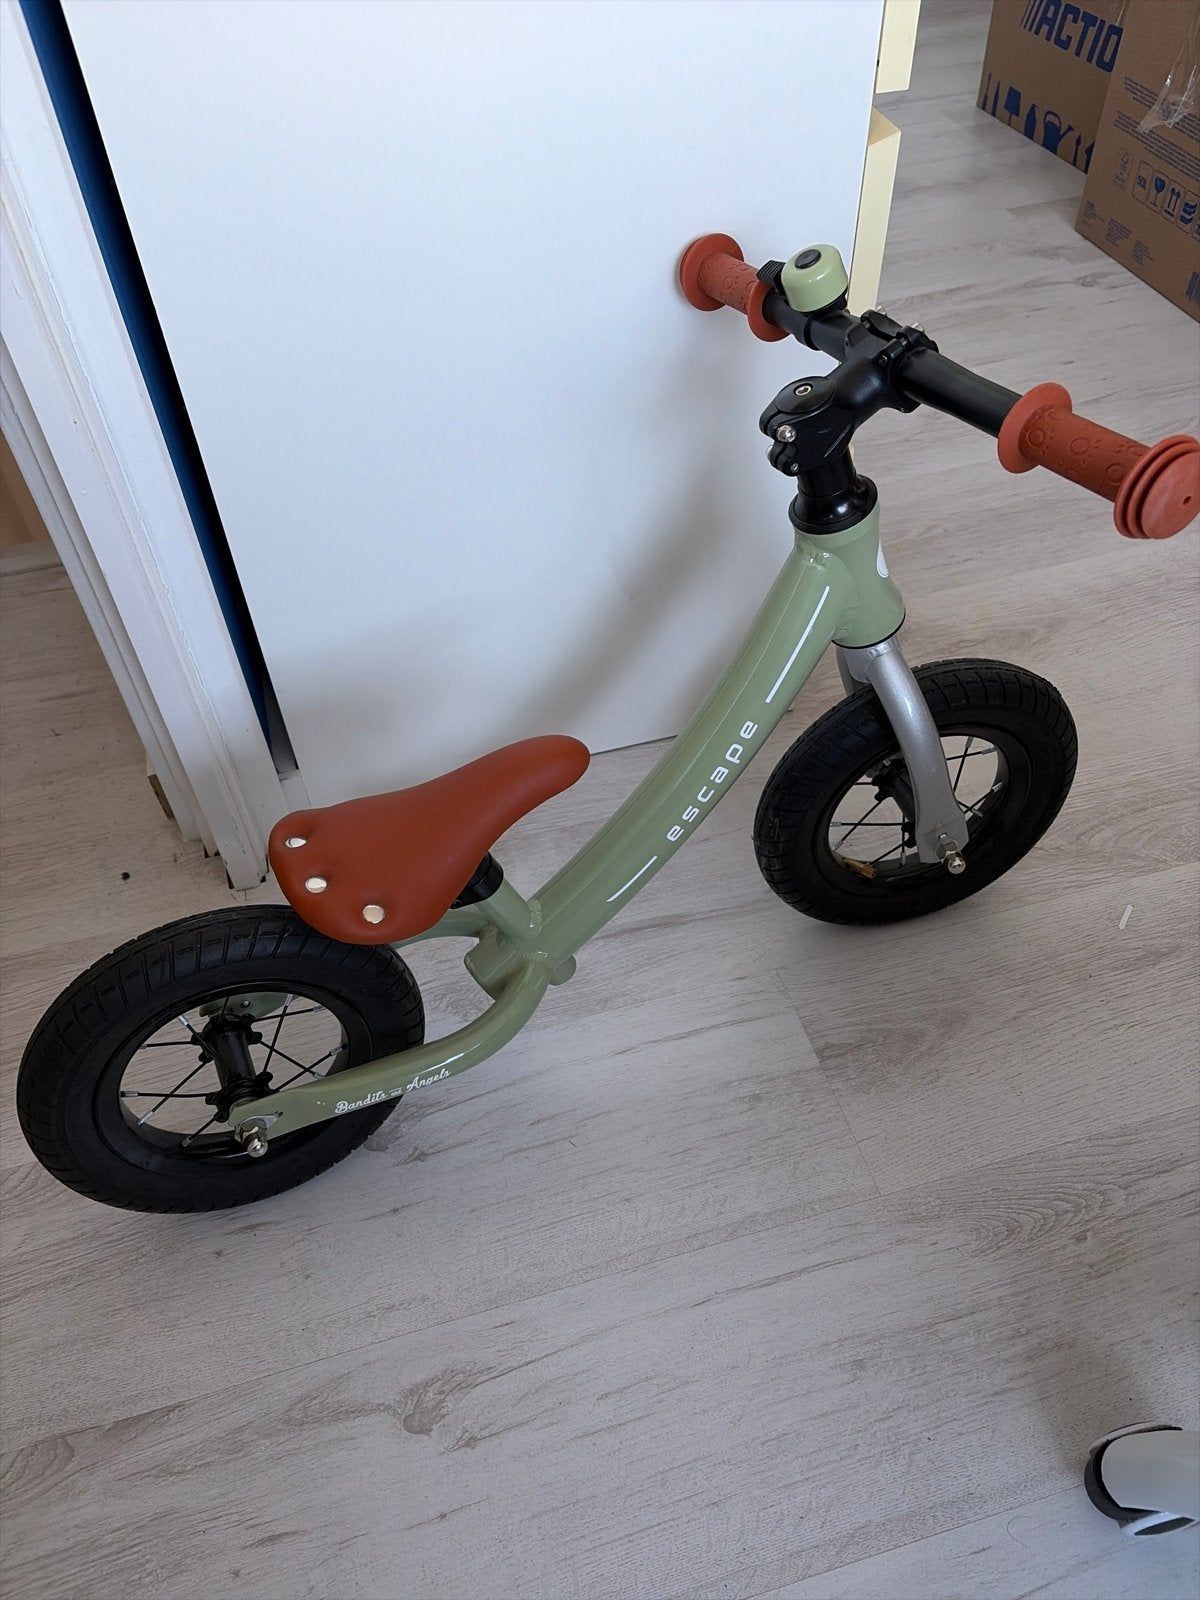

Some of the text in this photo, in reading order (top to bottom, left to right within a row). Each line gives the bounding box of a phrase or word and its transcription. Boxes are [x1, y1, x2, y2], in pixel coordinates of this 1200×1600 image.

[1034, 0, 1124, 73] ACTIO
[666, 720, 759, 842] escape
[335, 1091, 387, 1114] Bandits
[406, 1068, 451, 1093] Angels
